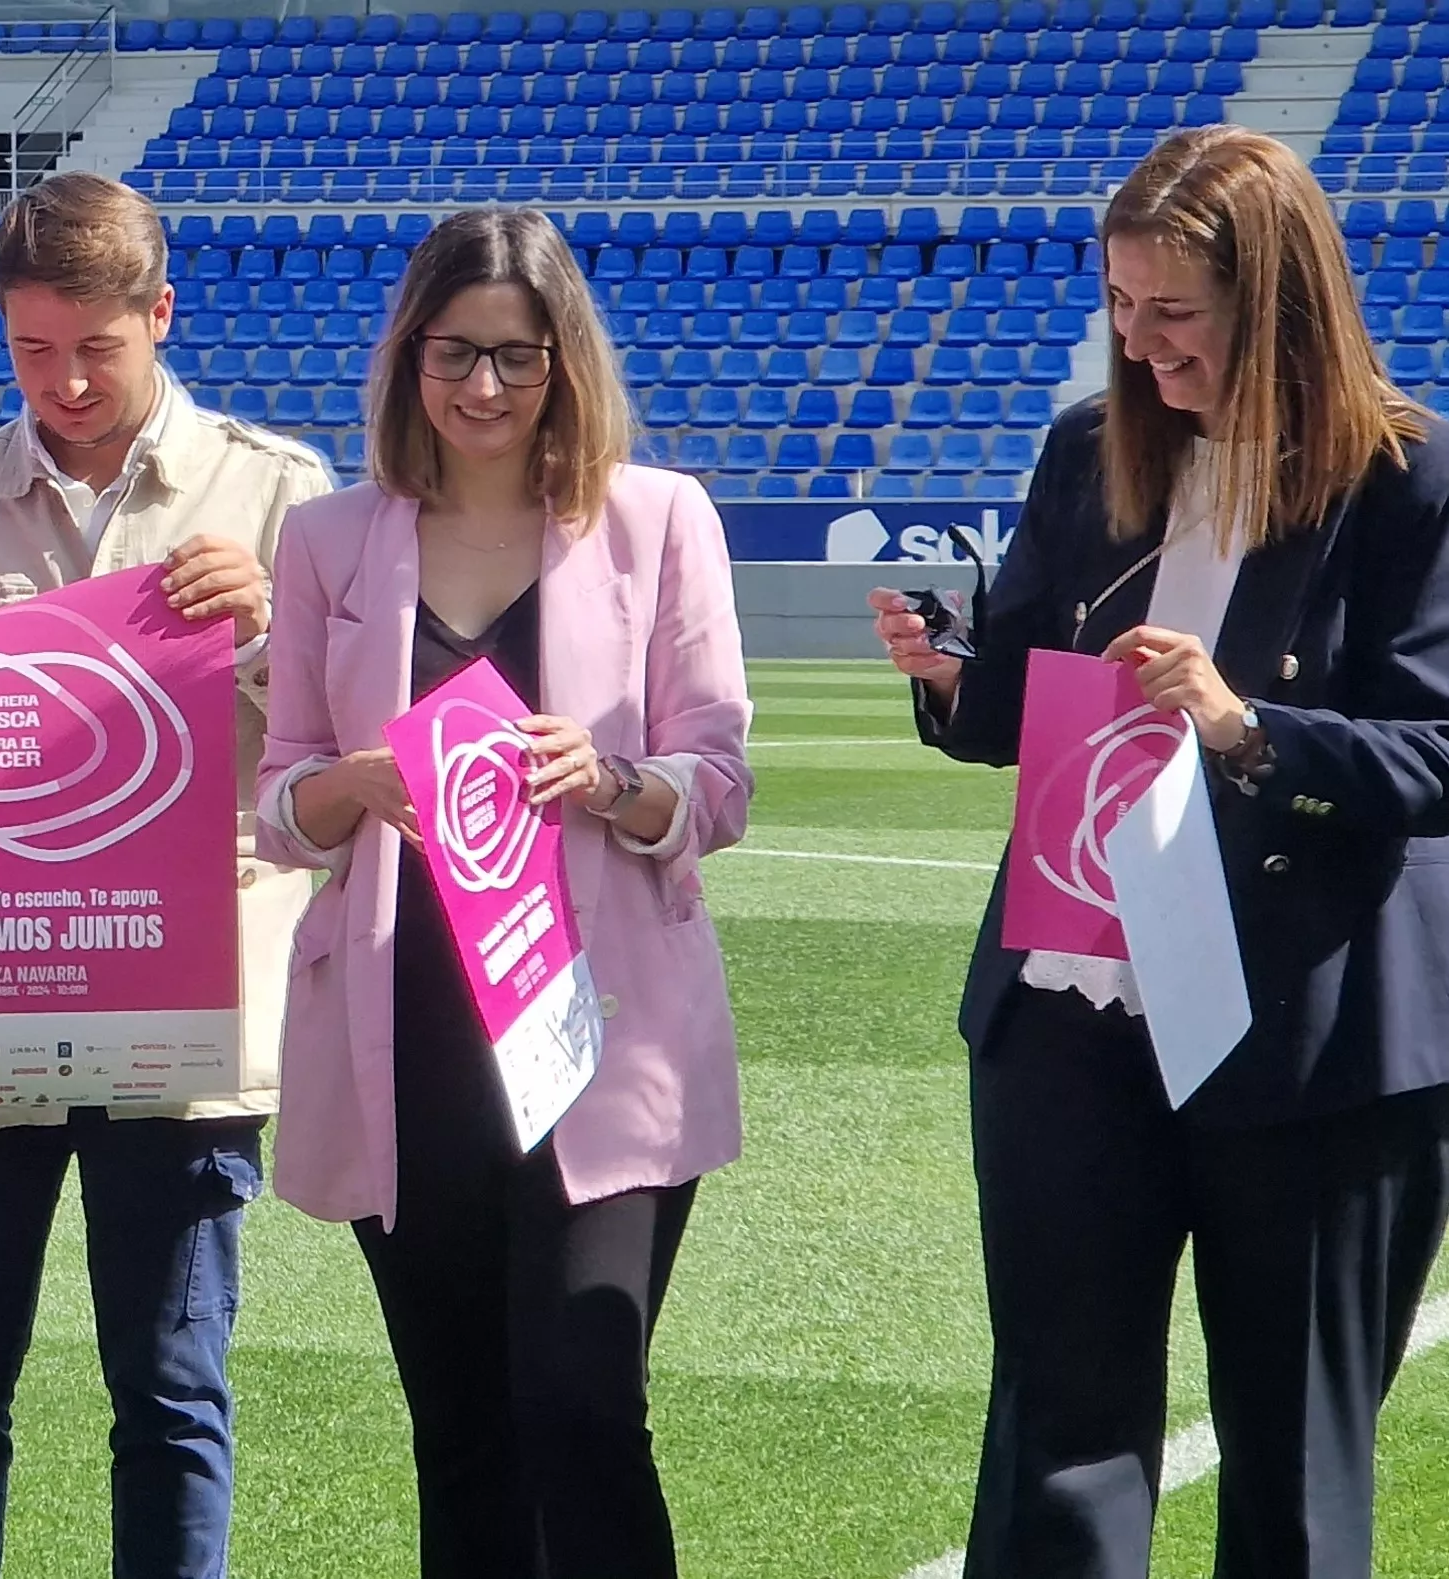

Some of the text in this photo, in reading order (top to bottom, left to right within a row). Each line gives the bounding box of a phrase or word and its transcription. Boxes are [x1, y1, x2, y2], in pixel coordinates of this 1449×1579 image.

[20, 736, 41, 750] EL
[15, 889, 86, 908] escucho,
[89, 888, 107, 906] Te
[111, 888, 163, 907] apoyo.
[60, 914, 164, 950] JUNTOS
[17, 965, 87, 982] NAVARRA
